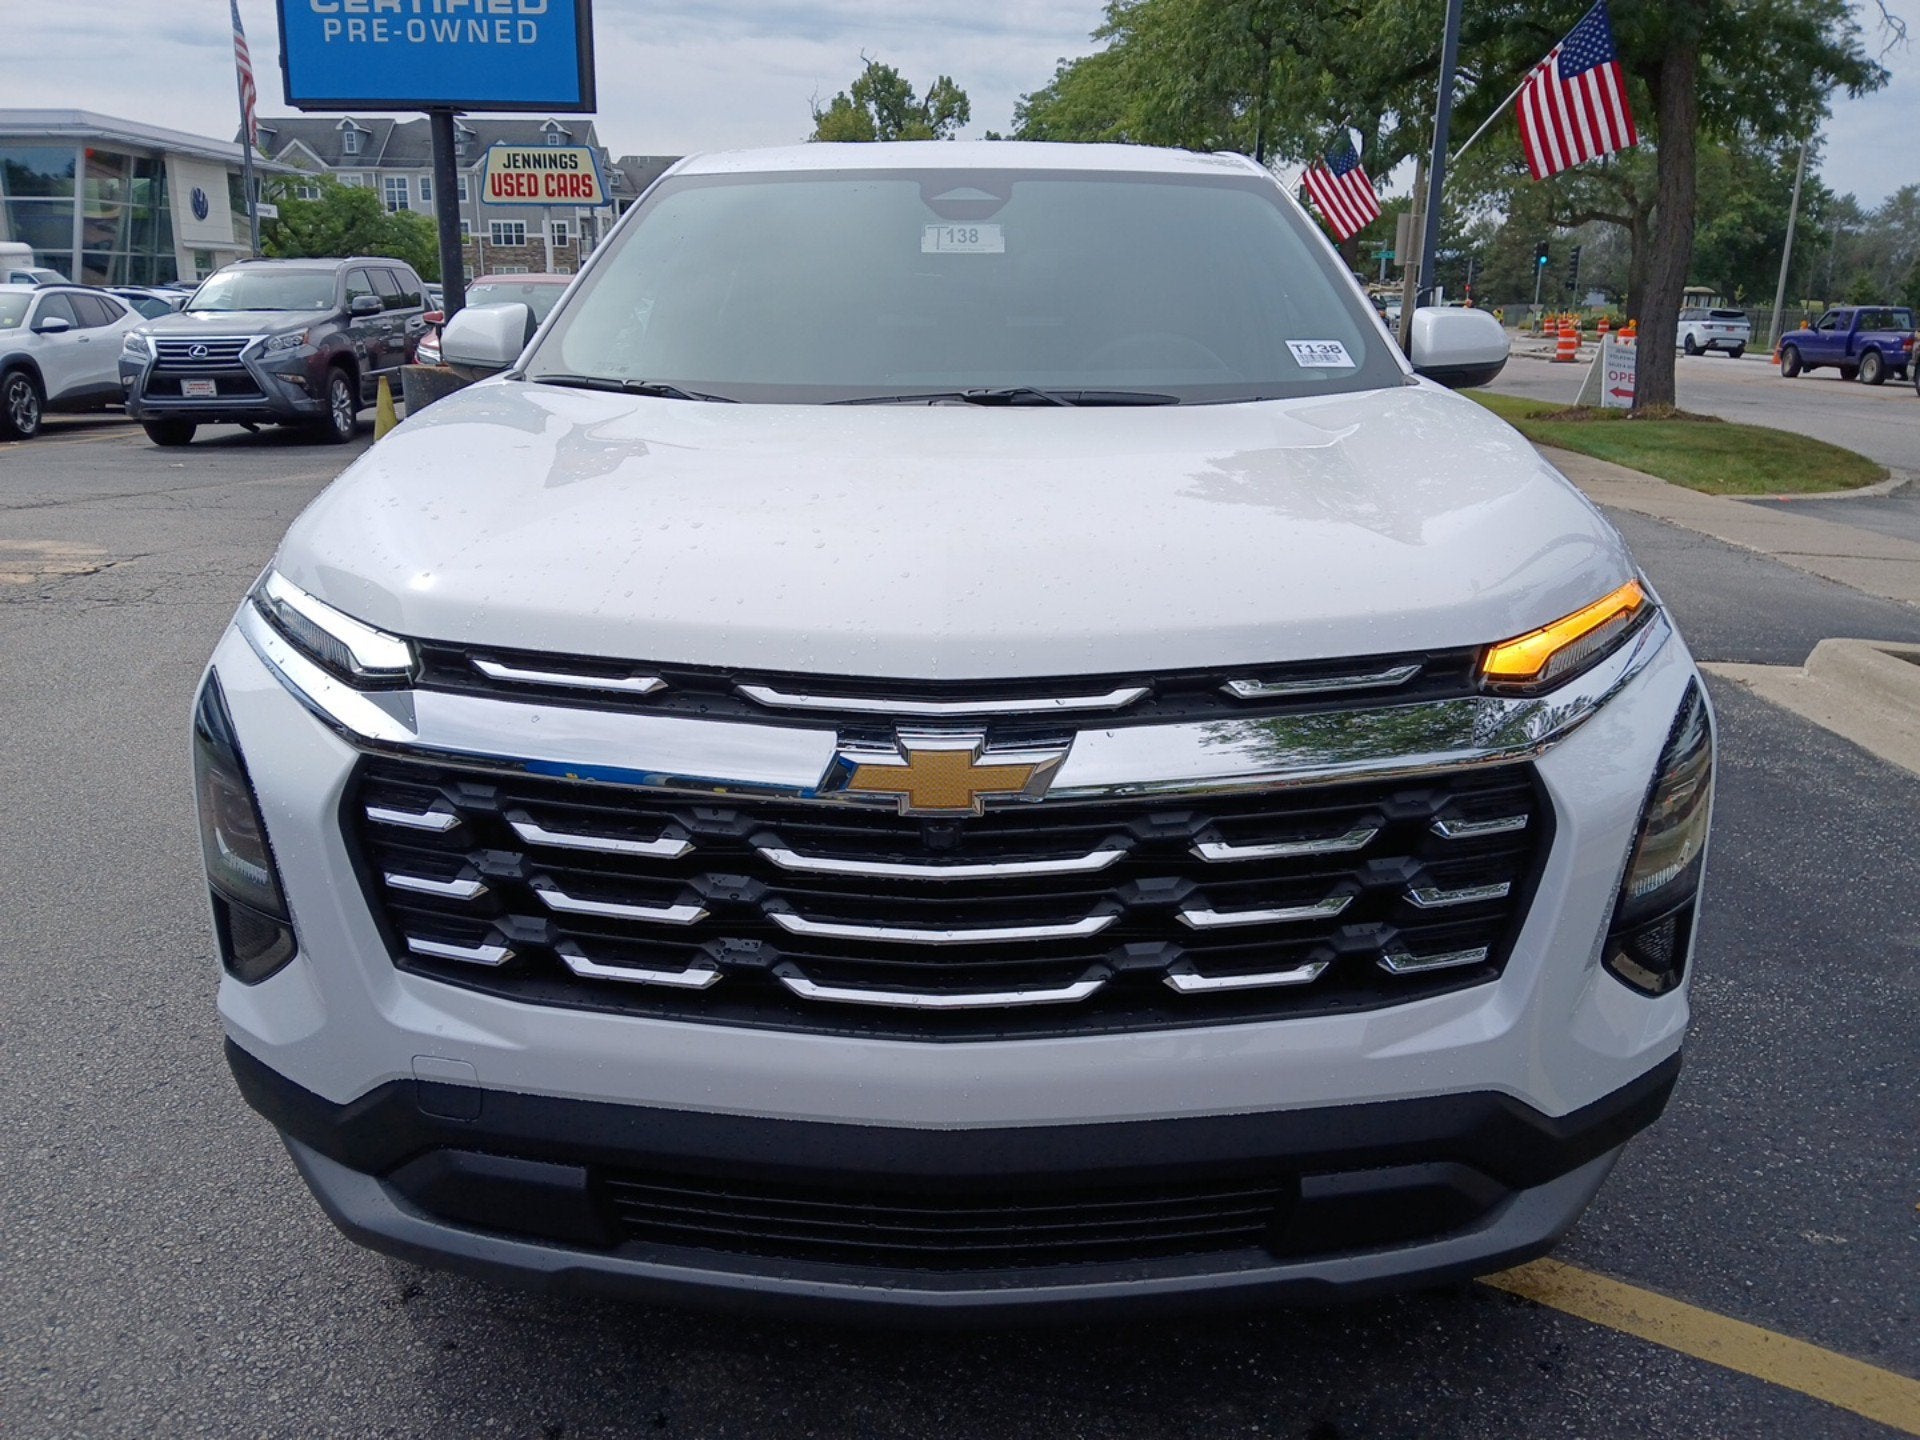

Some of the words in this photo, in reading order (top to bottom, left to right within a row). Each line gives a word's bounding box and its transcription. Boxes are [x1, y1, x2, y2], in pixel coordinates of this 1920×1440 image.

[323, 18, 538, 44] PRE-OWNED
[503, 153, 578, 169] JENNINGS
[491, 173, 540, 197] USED
[544, 173, 594, 198] CARS
[1291, 344, 1342, 354] T138
[1608, 370, 1636, 384] OPE
